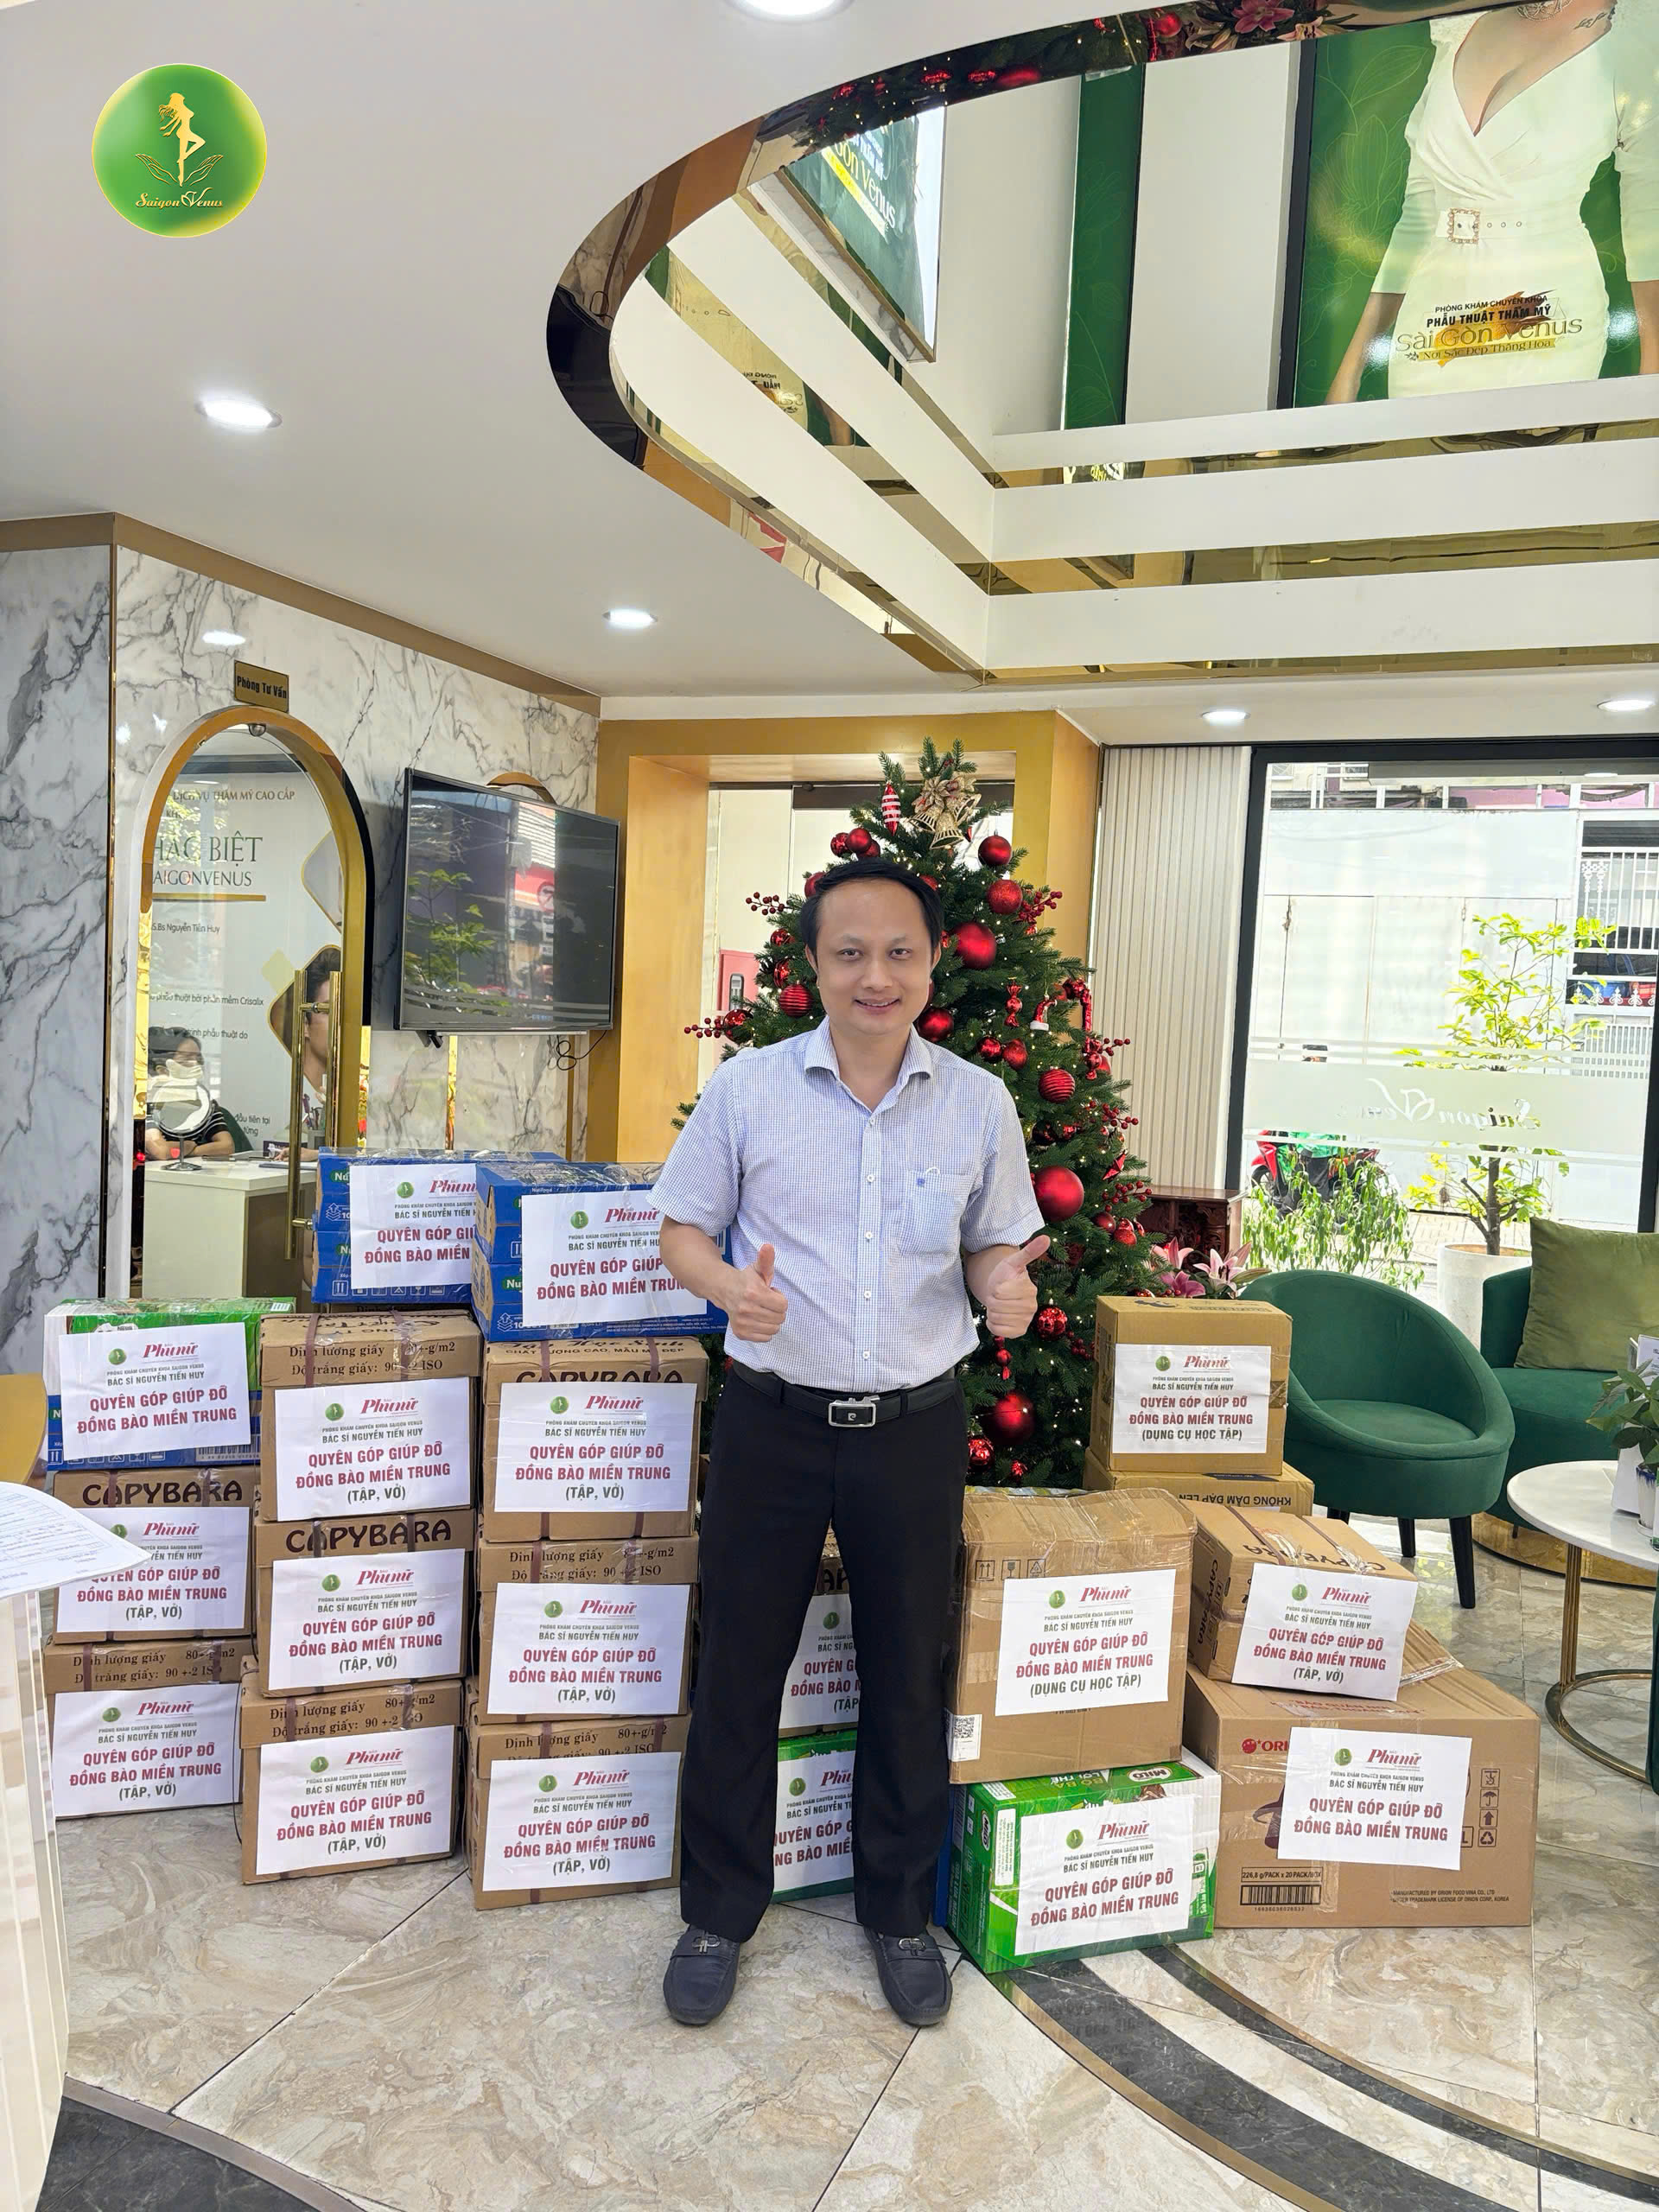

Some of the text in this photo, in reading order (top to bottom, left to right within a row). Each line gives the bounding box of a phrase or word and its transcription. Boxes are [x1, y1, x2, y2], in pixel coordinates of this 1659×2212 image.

[1435, 303, 1462, 313] PHÒNG
[1465, 301, 1488, 309] KHÁM
[1491, 297, 1523, 307] CHUYÊN
[1427, 303, 1551, 327] PHẪU THUẬT THẨM MỸ
[1440, 326, 1493, 346] Gòn
[237, 676, 287, 699] Phòng Tư Vấn
[240, 789, 254, 800] MỸ
[255, 791, 275, 800] CAO
[277, 786, 295, 800] CẤP
[209, 830, 263, 867] BIỆT
[153, 870, 252, 887] AIGONVENUS
[207, 925, 220, 935] Huy
[90, 1384, 228, 1412] QUYÊN GÓP GIÚP ĐỠ
[1141, 1395, 1248, 1408] QUYÊN GÓP GIÚP ĐỠ
[77, 1407, 237, 1435] ĐỒNG BÀO MIỀN TRUNG
[1129, 1410, 1253, 1425] ĐỒNG BÀO MIỀN TRUNG
[1178, 1429, 1192, 1441] CỤ
[1220, 1427, 1242, 1441] TẬP)
[308, 1440, 442, 1468] QUYÊN GÓP GIÚP ĐỠ
[296, 1463, 450, 1489] ĐỒNG BÀO MIỀN TRUNG
[82, 1479, 243, 1505] CAPYBARA
[1253, 1497, 1291, 1507] KHÔNG
[286, 1519, 451, 1553] CAPYBARA
[542, 1548, 604, 1562] lượng giấy
[512, 1570, 527, 1580] Độ
[603, 1567, 616, 1576] 90
[640, 1565, 661, 1576] ISO
[539, 1630, 556, 1640] BÁC
[568, 1630, 600, 1640] NGUYỄN
[603, 1630, 620, 1640] TIẾN
[105, 1650, 166, 1665] lượng giấy
[524, 1647, 656, 1662] QUYÊN GÓP GIÚP ĐỠ
[166, 1669, 178, 1677] 90
[509, 1666, 662, 1682] ĐỒNG BÀO MIỀN TRUNG
[557, 1687, 616, 1704] (TẬP, VỞ)
[1261, 1739, 1289, 1752] ORI
[1133, 1770, 1166, 1778] MILO
[1329, 1778, 1345, 1789] BÁC
[1357, 1779, 1388, 1792] NGUYỄN
[1389, 1781, 1406, 1792] TIẾN
[1408, 1783, 1424, 1793] HUY
[1309, 1797, 1443, 1819] QUYÊN GÓP GIÚP ĐỠ
[1294, 1817, 1448, 1841] ĐỒNG BÀO MIỀN TRUNG
[1046, 1867, 1173, 1903] QUYÊN GÓP GIÚP ĐỠ
[1031, 1905, 1067, 1927] ĐỒNG
[1071, 1899, 1097, 1920] BÀO
[1101, 1895, 1134, 1916] MIỀN
[1138, 1891, 1179, 1908] TRUNG
